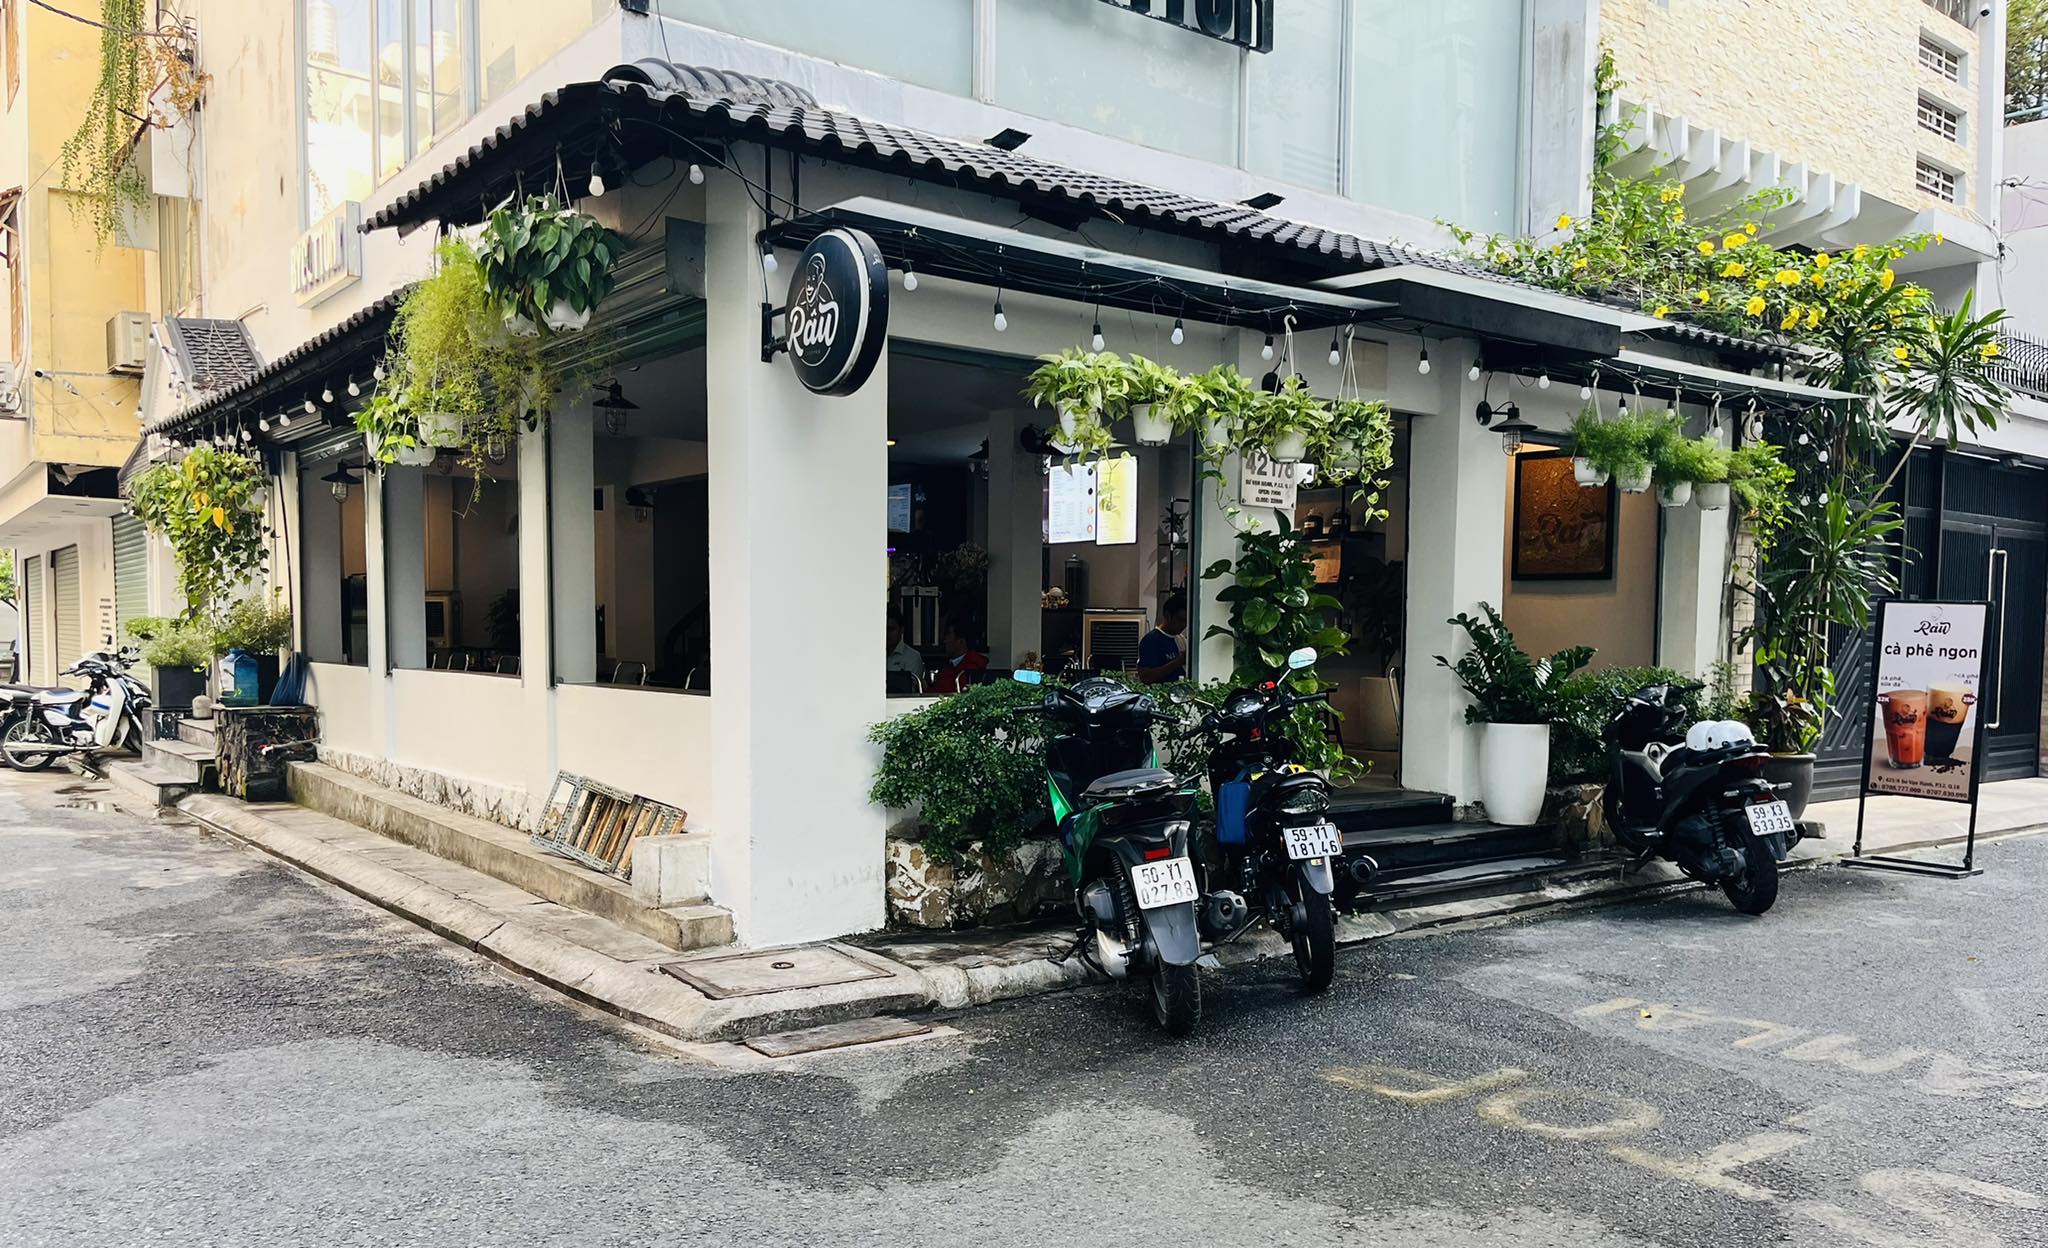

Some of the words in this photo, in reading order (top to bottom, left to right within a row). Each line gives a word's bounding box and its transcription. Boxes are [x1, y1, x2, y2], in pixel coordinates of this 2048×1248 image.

[1885, 642, 1901, 655] cà
[1906, 643, 1934, 658] phê
[1939, 647, 1977, 660] ngon
[1292, 826, 1328, 842] 59-Y1
[1291, 840, 1338, 857] 181.46
